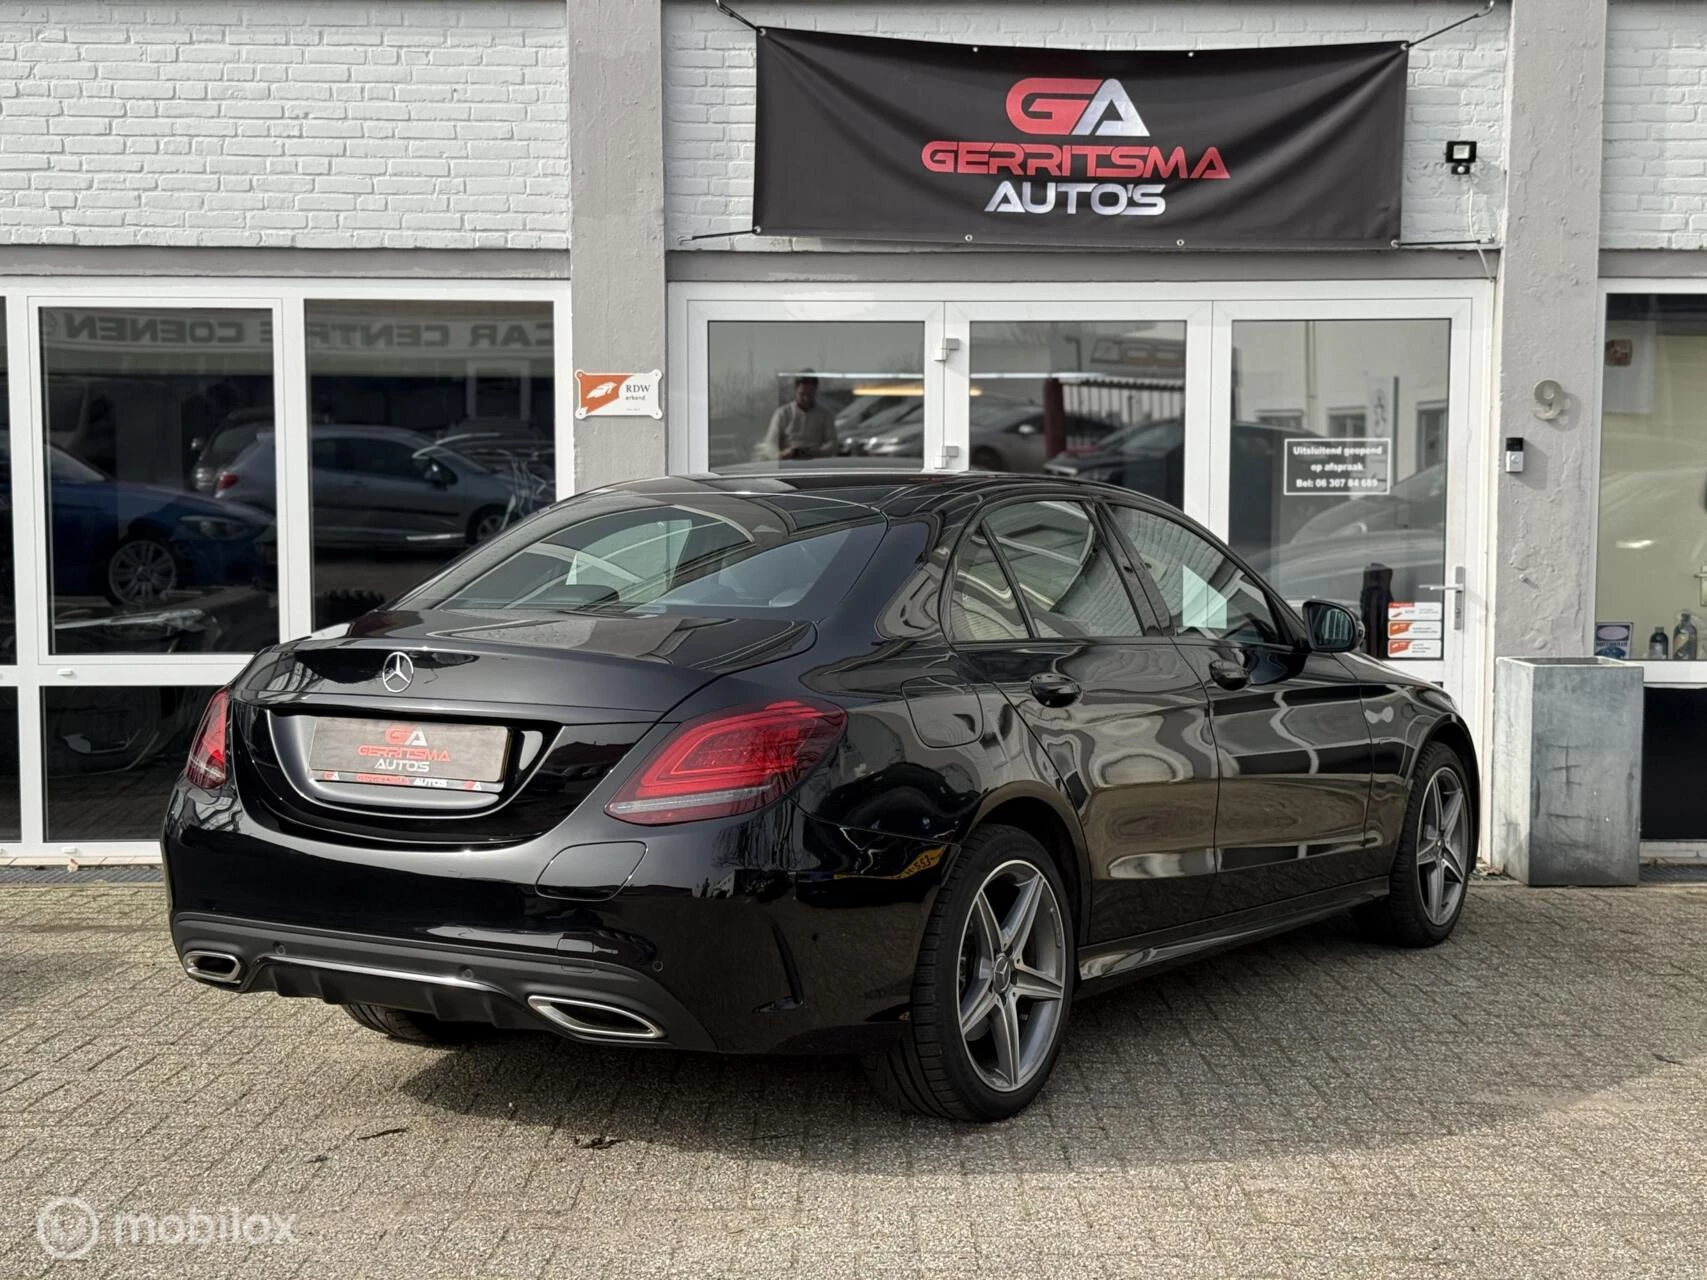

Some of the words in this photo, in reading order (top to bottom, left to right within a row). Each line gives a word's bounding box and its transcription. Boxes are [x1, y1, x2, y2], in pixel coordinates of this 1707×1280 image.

[1005, 77, 1150, 137] GA
[921, 141, 1231, 179] GERRITSMA
[984, 180, 1166, 216] AUTO'S
[625, 384, 651, 393] RDW
[1532, 378, 1567, 421] 9
[1293, 446, 1342, 455] Uitsluitend
[1343, 446, 1382, 456] geopend
[1310, 464, 1323, 473] op
[1324, 462, 1364, 473] afspraak
[1315, 478, 1327, 488] 06
[384, 724, 428, 746] GA
[357, 745, 450, 762] GERRITSMA
[374, 758, 430, 772] AUTO'S
